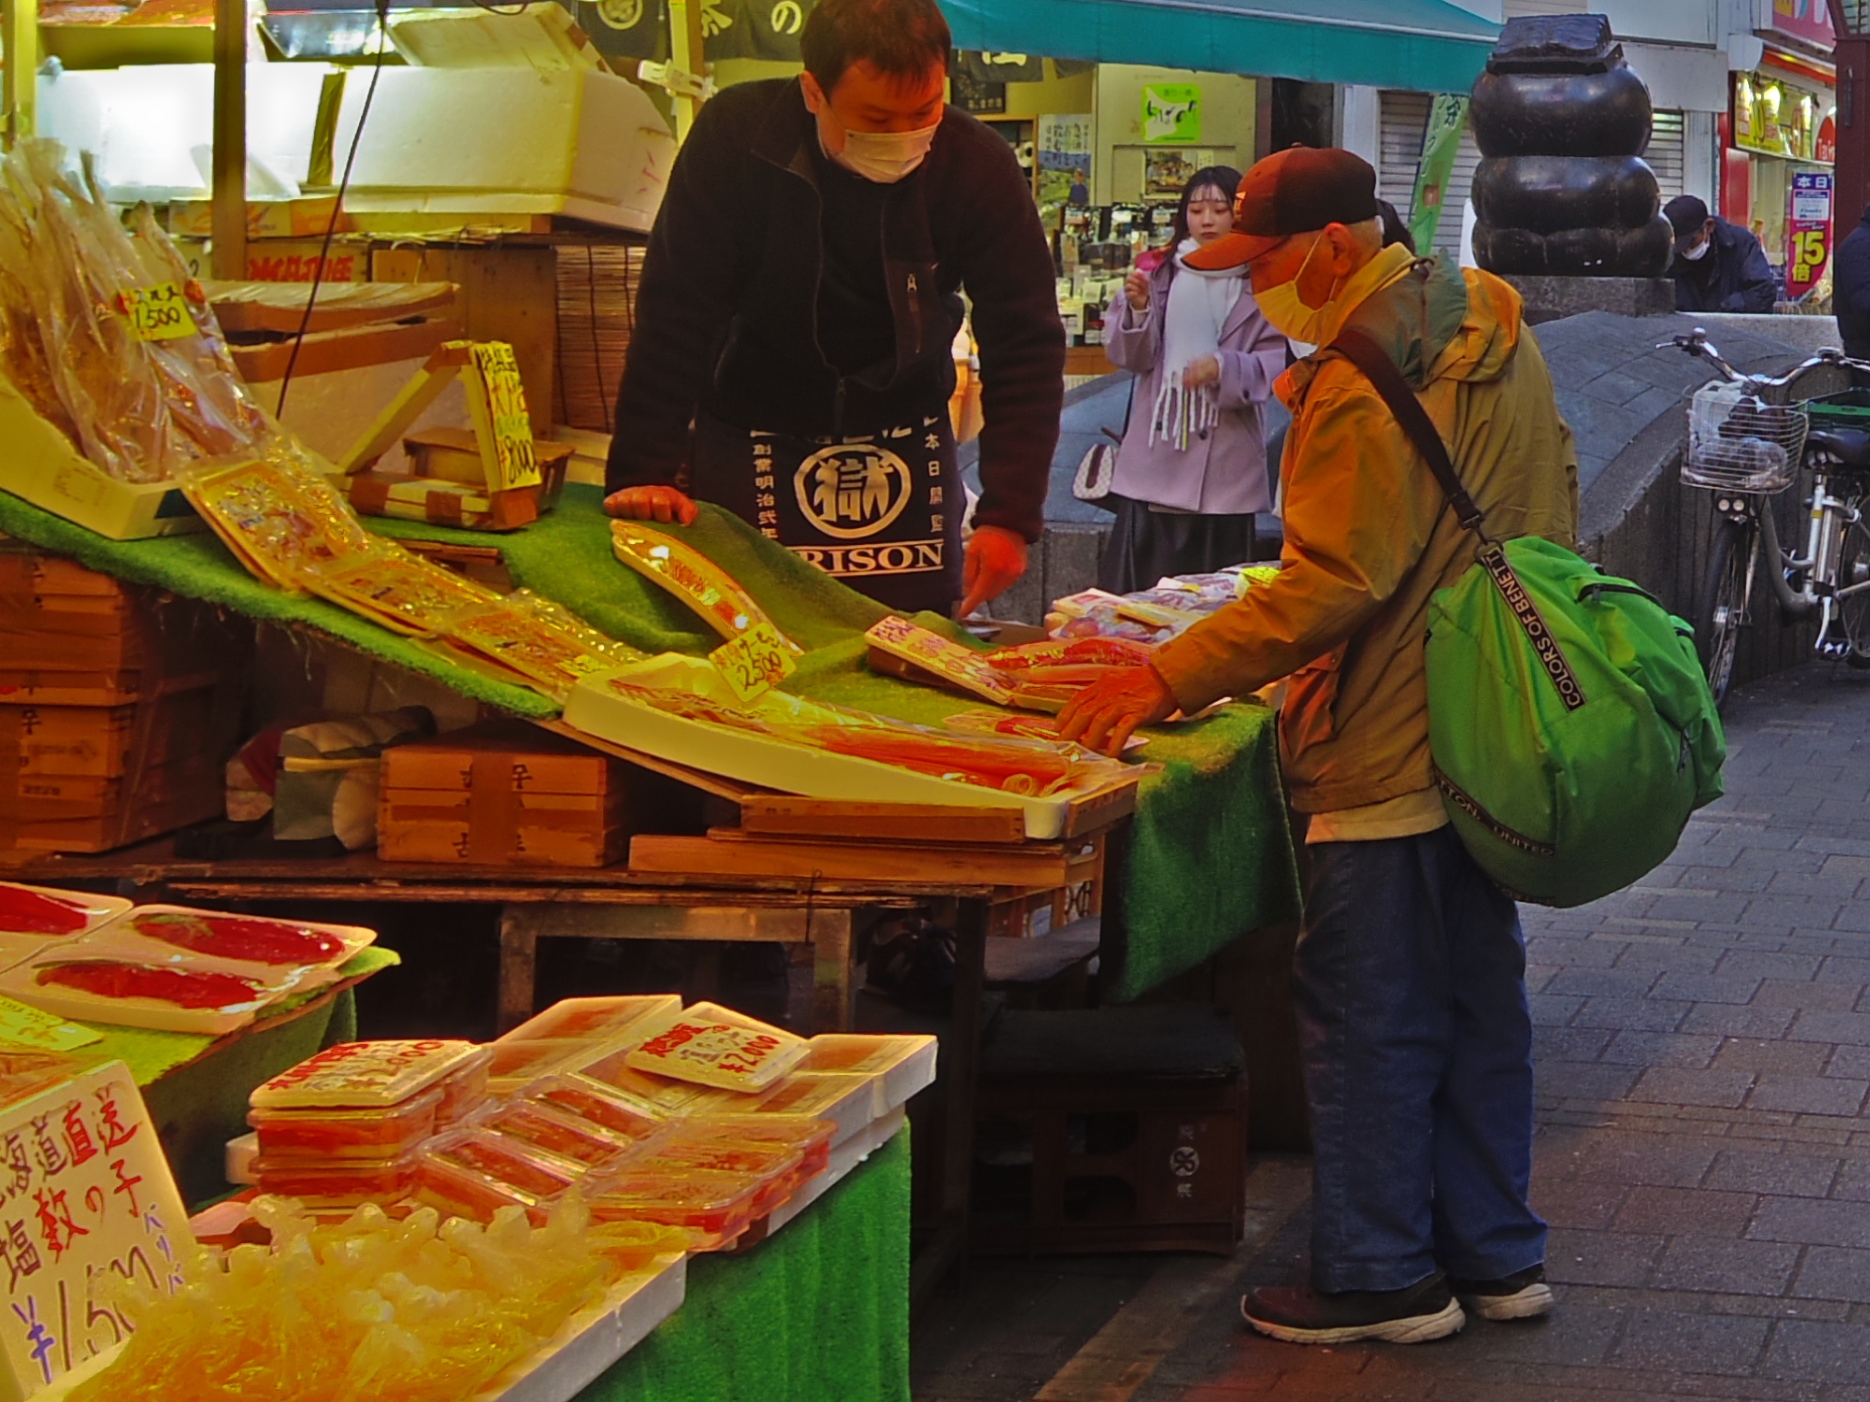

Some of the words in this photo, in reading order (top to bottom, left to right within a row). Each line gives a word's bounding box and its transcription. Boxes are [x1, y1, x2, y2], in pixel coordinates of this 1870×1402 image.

[1797, 176, 1828, 189] 本日
[1791, 230, 1826, 266] 15
[1521, 613, 1543, 636] OF
[1536, 636, 1582, 707] COLORS
